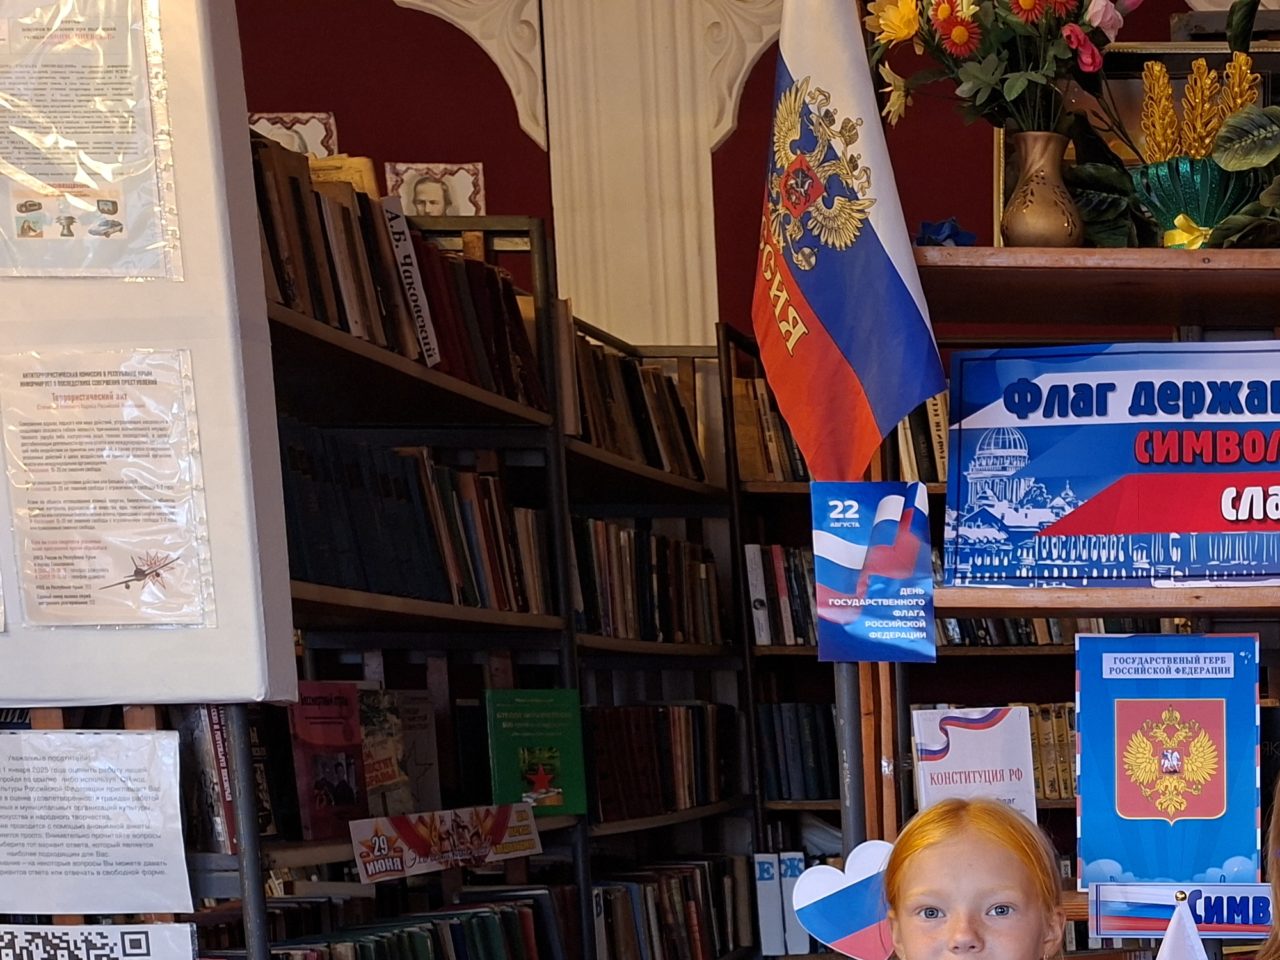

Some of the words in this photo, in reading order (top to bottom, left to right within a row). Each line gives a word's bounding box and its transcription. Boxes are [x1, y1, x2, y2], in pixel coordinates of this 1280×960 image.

[761, 246, 809, 357] СИЯ
[828, 500, 860, 519] 22
[900, 588, 925, 596] ДЕНЬ
[828, 598, 925, 606] ГОСУДАРСТВЕННОГО
[865, 619, 926, 628] РОССИЙСКОЙ
[868, 631, 927, 640] ФЕДЕРАЦИИ
[1203, 656, 1226, 664] ГЕРБ
[1109, 665, 1171, 675] РОССИЙСКОЙ
[1175, 666, 1231, 676] ФЕДЕРАЦИИ
[930, 769, 1004, 785] КОНСТИТУЦИЯ
[1009, 768, 1023, 782] РФ
[372, 835, 388, 856] 29
[365, 857, 403, 876] ИЮНЯ
[1188, 889, 1271, 924] Симв
